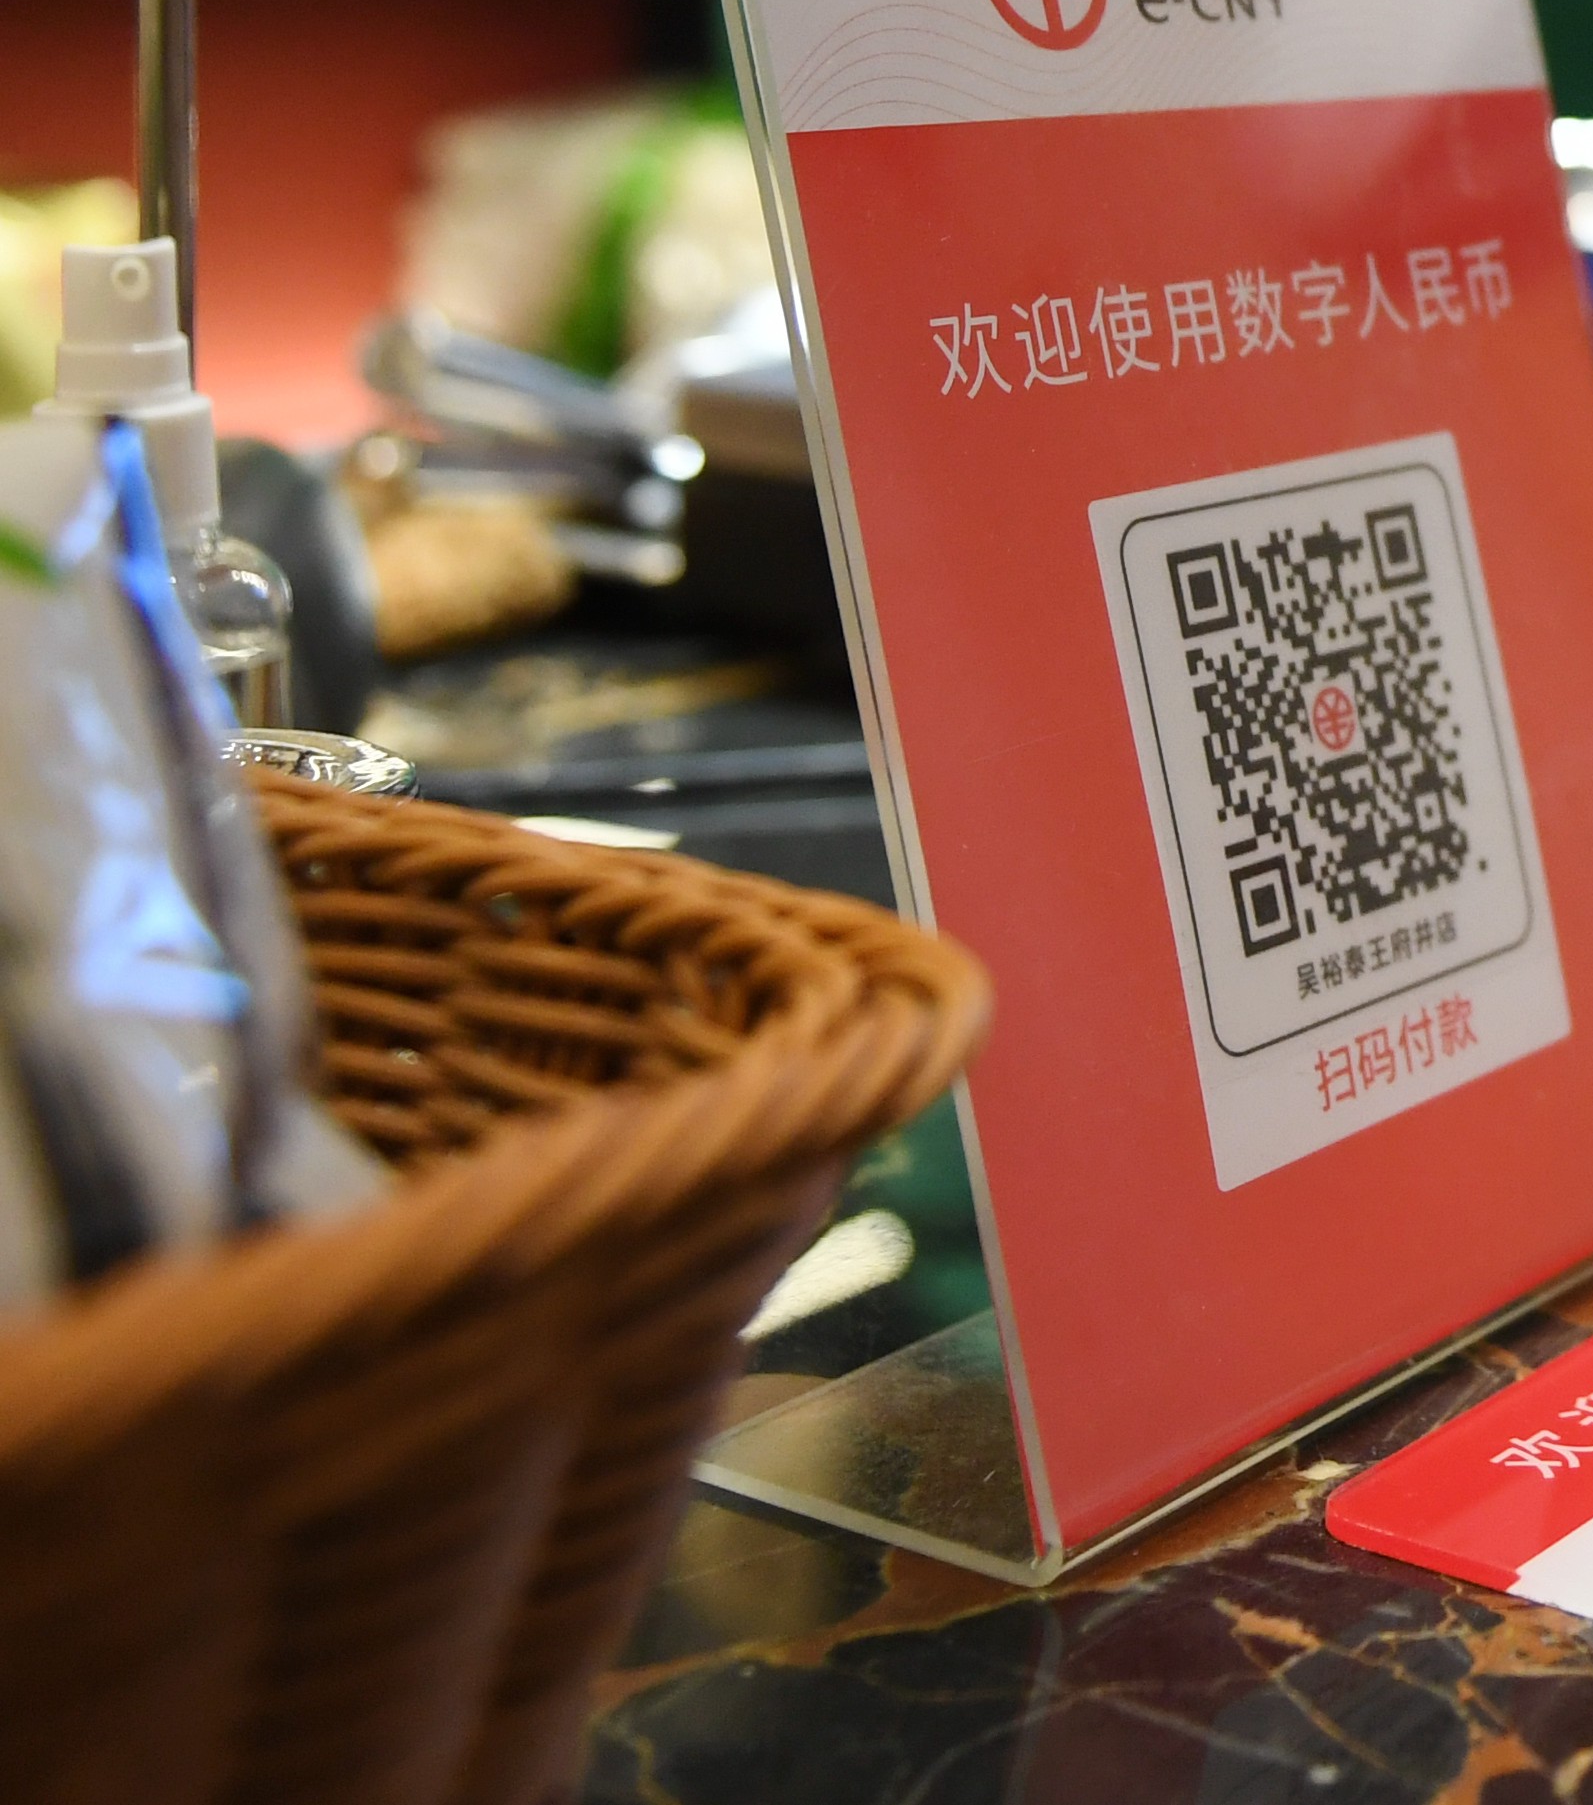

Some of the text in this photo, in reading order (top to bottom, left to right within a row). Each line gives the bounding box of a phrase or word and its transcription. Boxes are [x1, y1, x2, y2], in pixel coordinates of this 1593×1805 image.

[928, 238, 1513, 399] 欢迎使用数字人民币
[1297, 910, 1457, 1000] 吴裕泰王府井店
[1314, 991, 1478, 1113] 扫码付款
